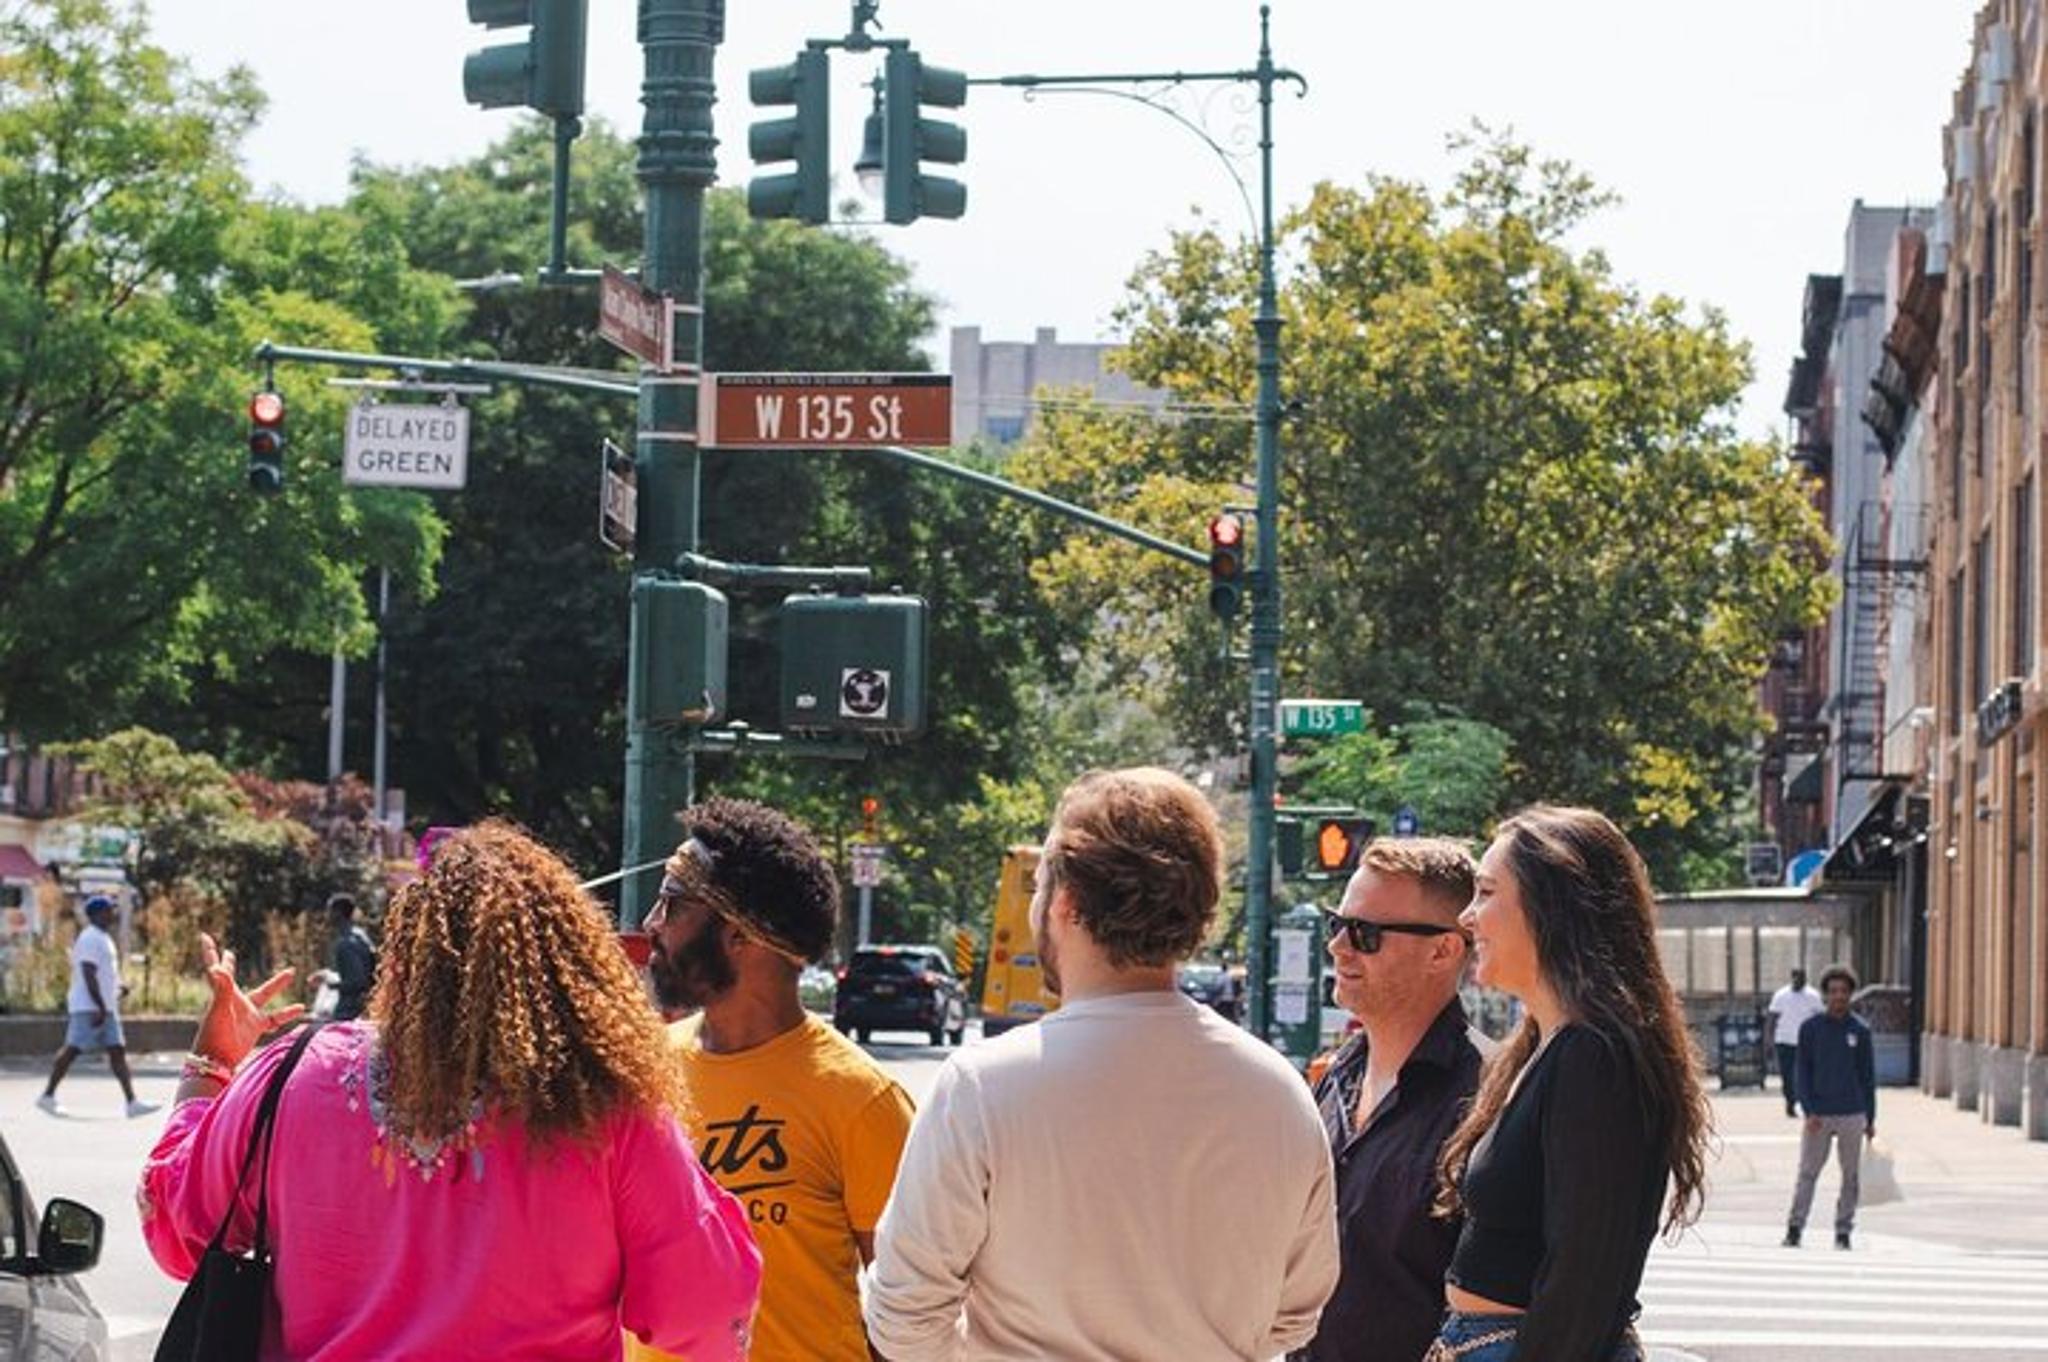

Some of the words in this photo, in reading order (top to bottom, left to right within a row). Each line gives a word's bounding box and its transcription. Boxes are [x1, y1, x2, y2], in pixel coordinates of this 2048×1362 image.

[358, 416, 456, 442] DELAYED
[755, 395, 783, 439] W
[797, 395, 854, 440] 135
[867, 395, 902, 440] St
[358, 449, 453, 474] GREEN
[1284, 705, 1300, 729] W
[1308, 705, 1336, 729] 135
